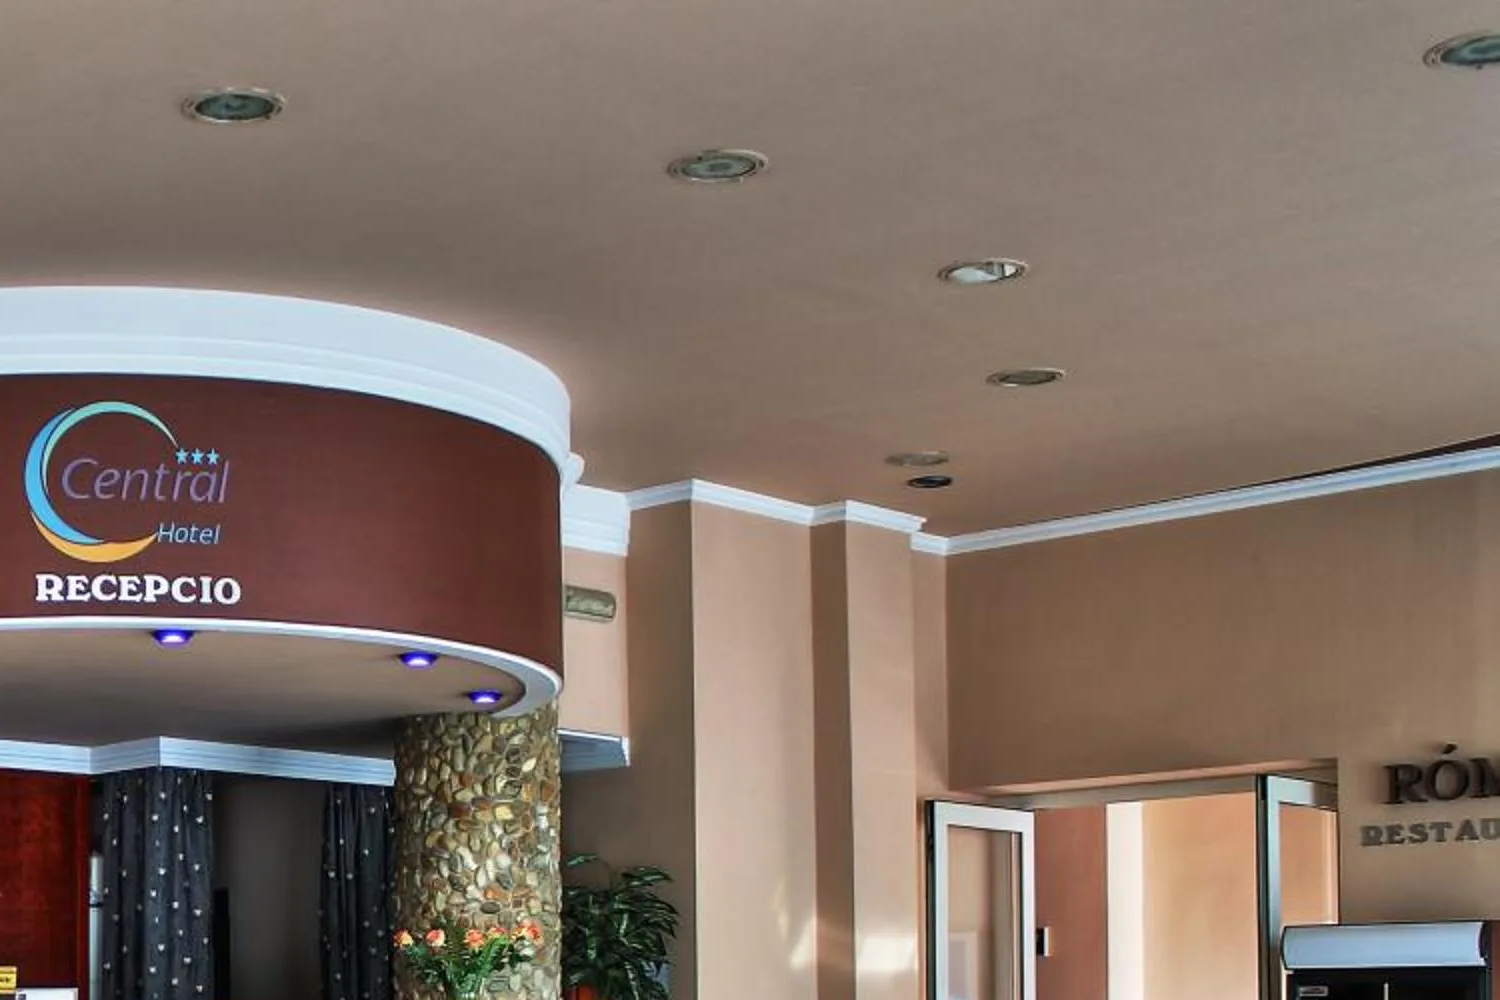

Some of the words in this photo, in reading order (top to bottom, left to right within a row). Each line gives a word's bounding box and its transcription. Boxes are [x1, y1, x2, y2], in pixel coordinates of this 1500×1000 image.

[61, 457, 230, 504] Central
[156, 521, 221, 545] Hotel
[35, 573, 242, 604] RECEPCIO
[1361, 817, 1500, 847] RESTAU
